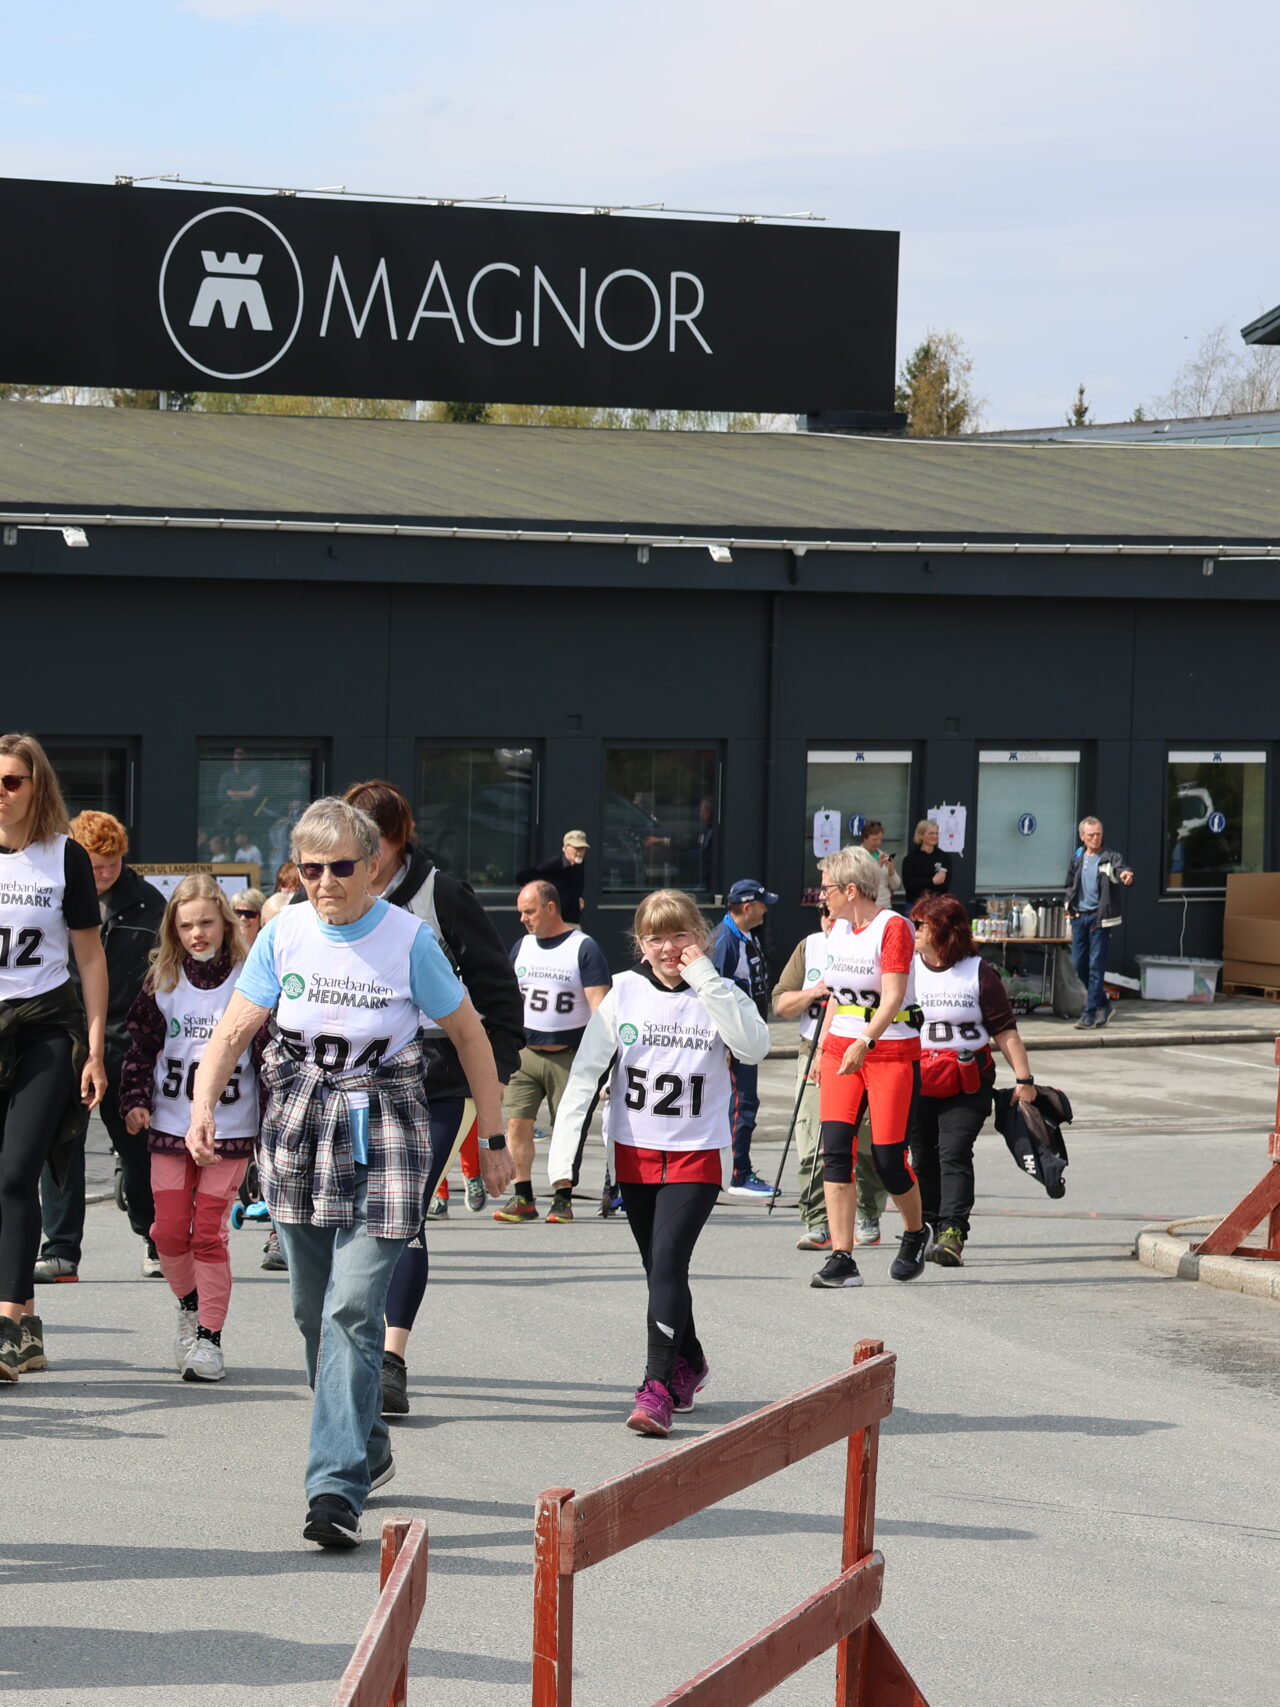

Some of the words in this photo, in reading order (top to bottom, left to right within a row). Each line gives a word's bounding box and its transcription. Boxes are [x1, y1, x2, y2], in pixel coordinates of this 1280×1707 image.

[320, 256, 713, 355] MAGNOR
[527, 970, 572, 982] HEDMARK
[831, 963, 875, 975] HEDMARK
[310, 973, 394, 996] Sparebanken
[307, 988, 390, 1009] HEDMARK
[920, 999, 976, 1009] HEDMARK
[642, 1020, 714, 1037] Sparebanken
[641, 1033, 713, 1051] HEDMARK
[624, 1065, 707, 1118] 521
